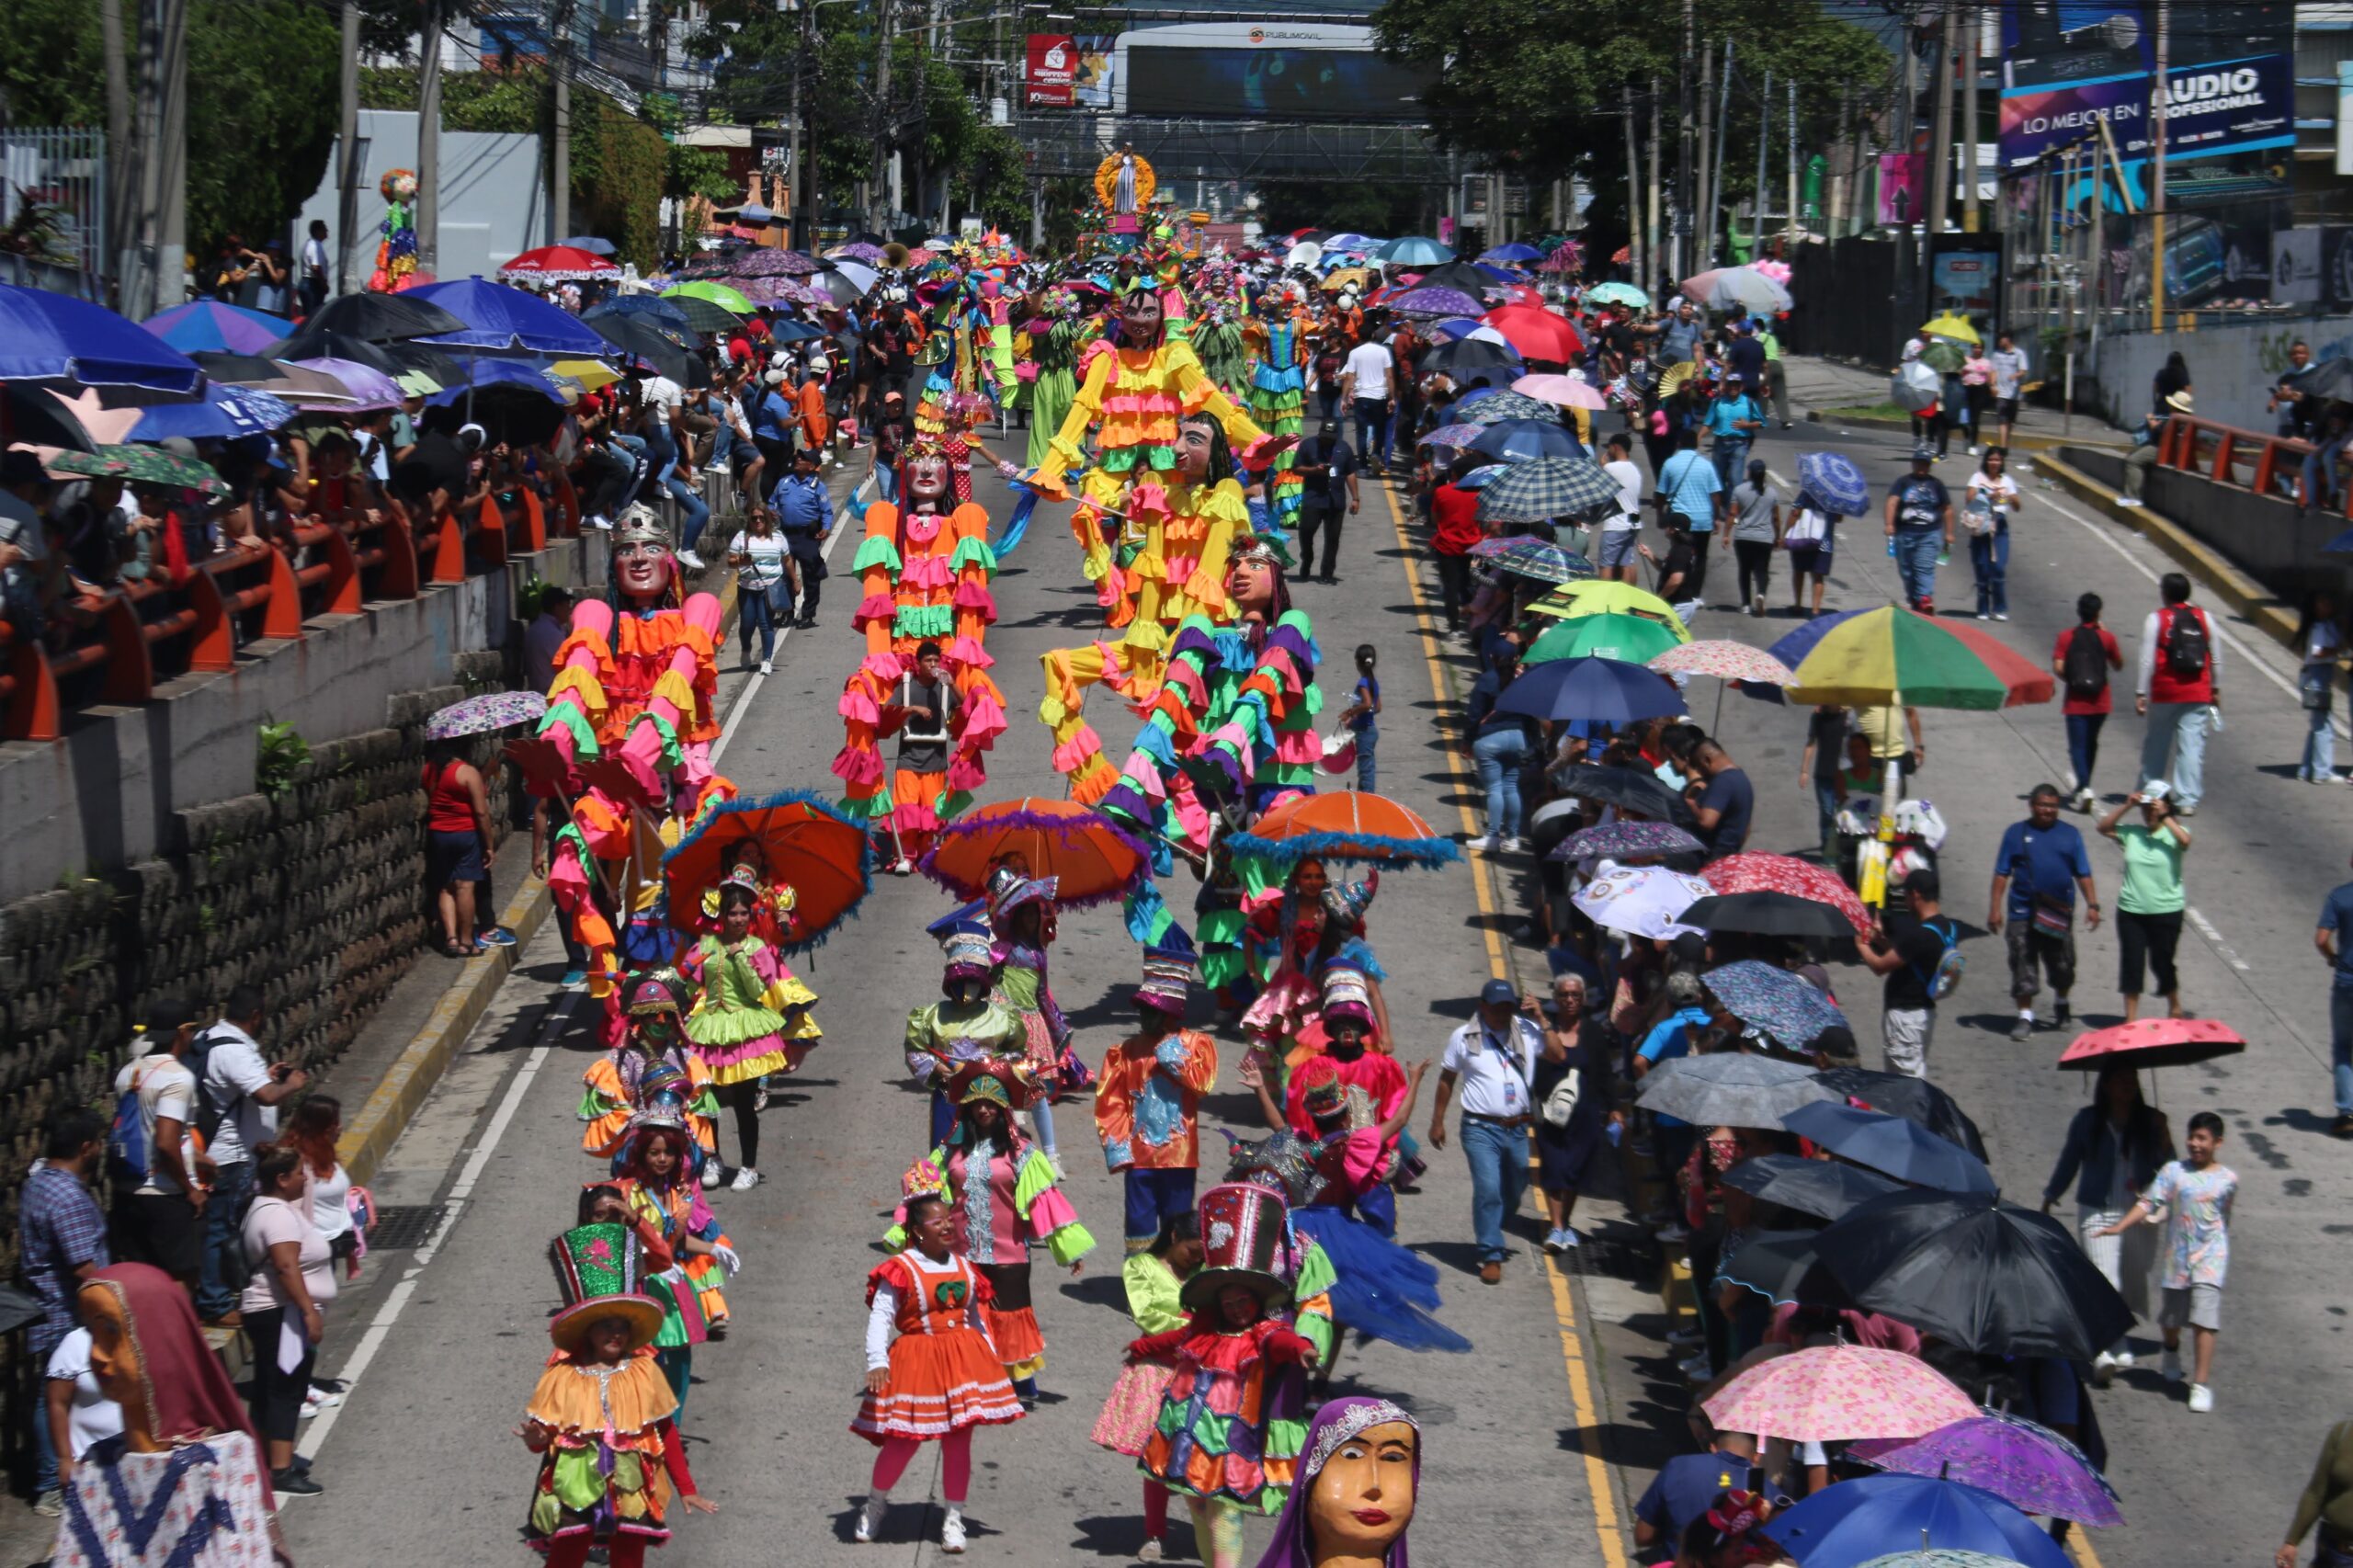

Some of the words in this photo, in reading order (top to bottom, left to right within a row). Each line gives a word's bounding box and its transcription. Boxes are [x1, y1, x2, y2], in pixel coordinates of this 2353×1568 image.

[1033, 70, 1071, 78] SHOPPING
[2151, 68, 2259, 107] AUDIO
[2023, 117, 2048, 134] LO
[2051, 108, 2112, 131] MEJOR
[2114, 102, 2141, 120] EN
[2151, 93, 2266, 119] OFESIONAL
